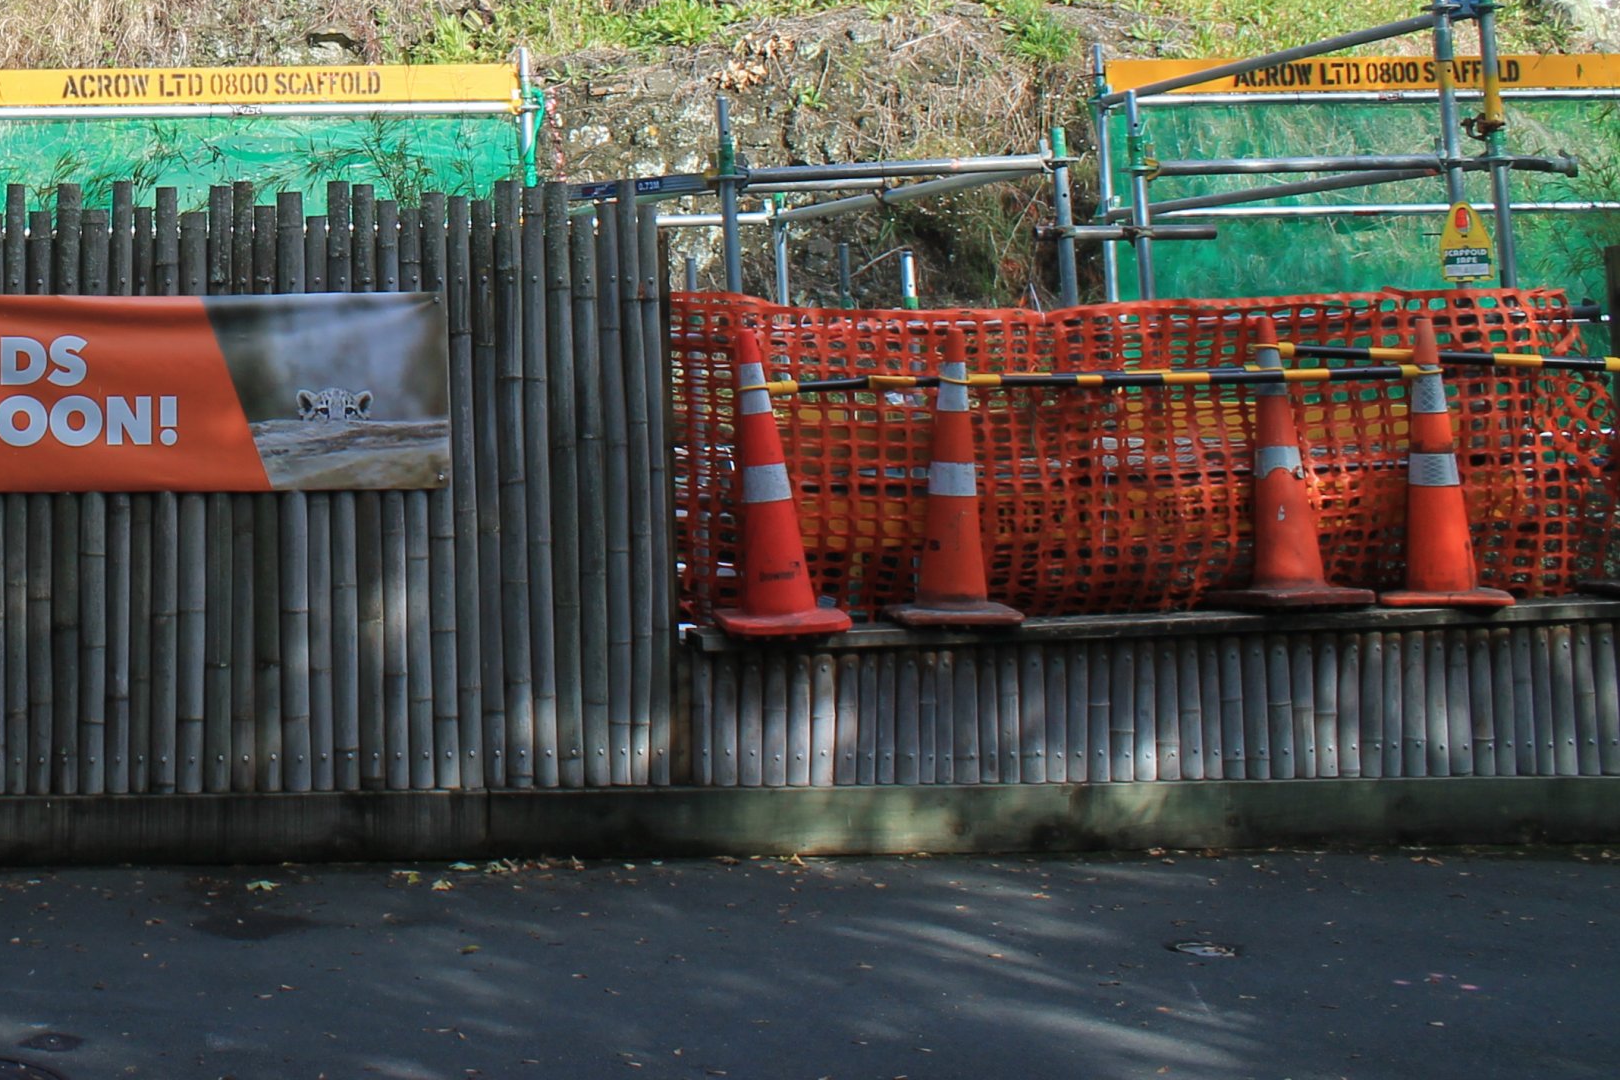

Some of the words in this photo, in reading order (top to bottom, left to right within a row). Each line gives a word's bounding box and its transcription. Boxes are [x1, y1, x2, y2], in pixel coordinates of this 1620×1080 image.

[62, 74, 149, 99] ACROW
[159, 73, 203, 97] LTD
[210, 72, 268, 96] 0800
[274, 71, 381, 95] SCAFFOLD
[1234, 62, 1312, 88] ACROW
[1320, 62, 1360, 85] LTD
[1366, 60, 1419, 84] 0800
[1423, 59, 1520, 83] SAFFLD
